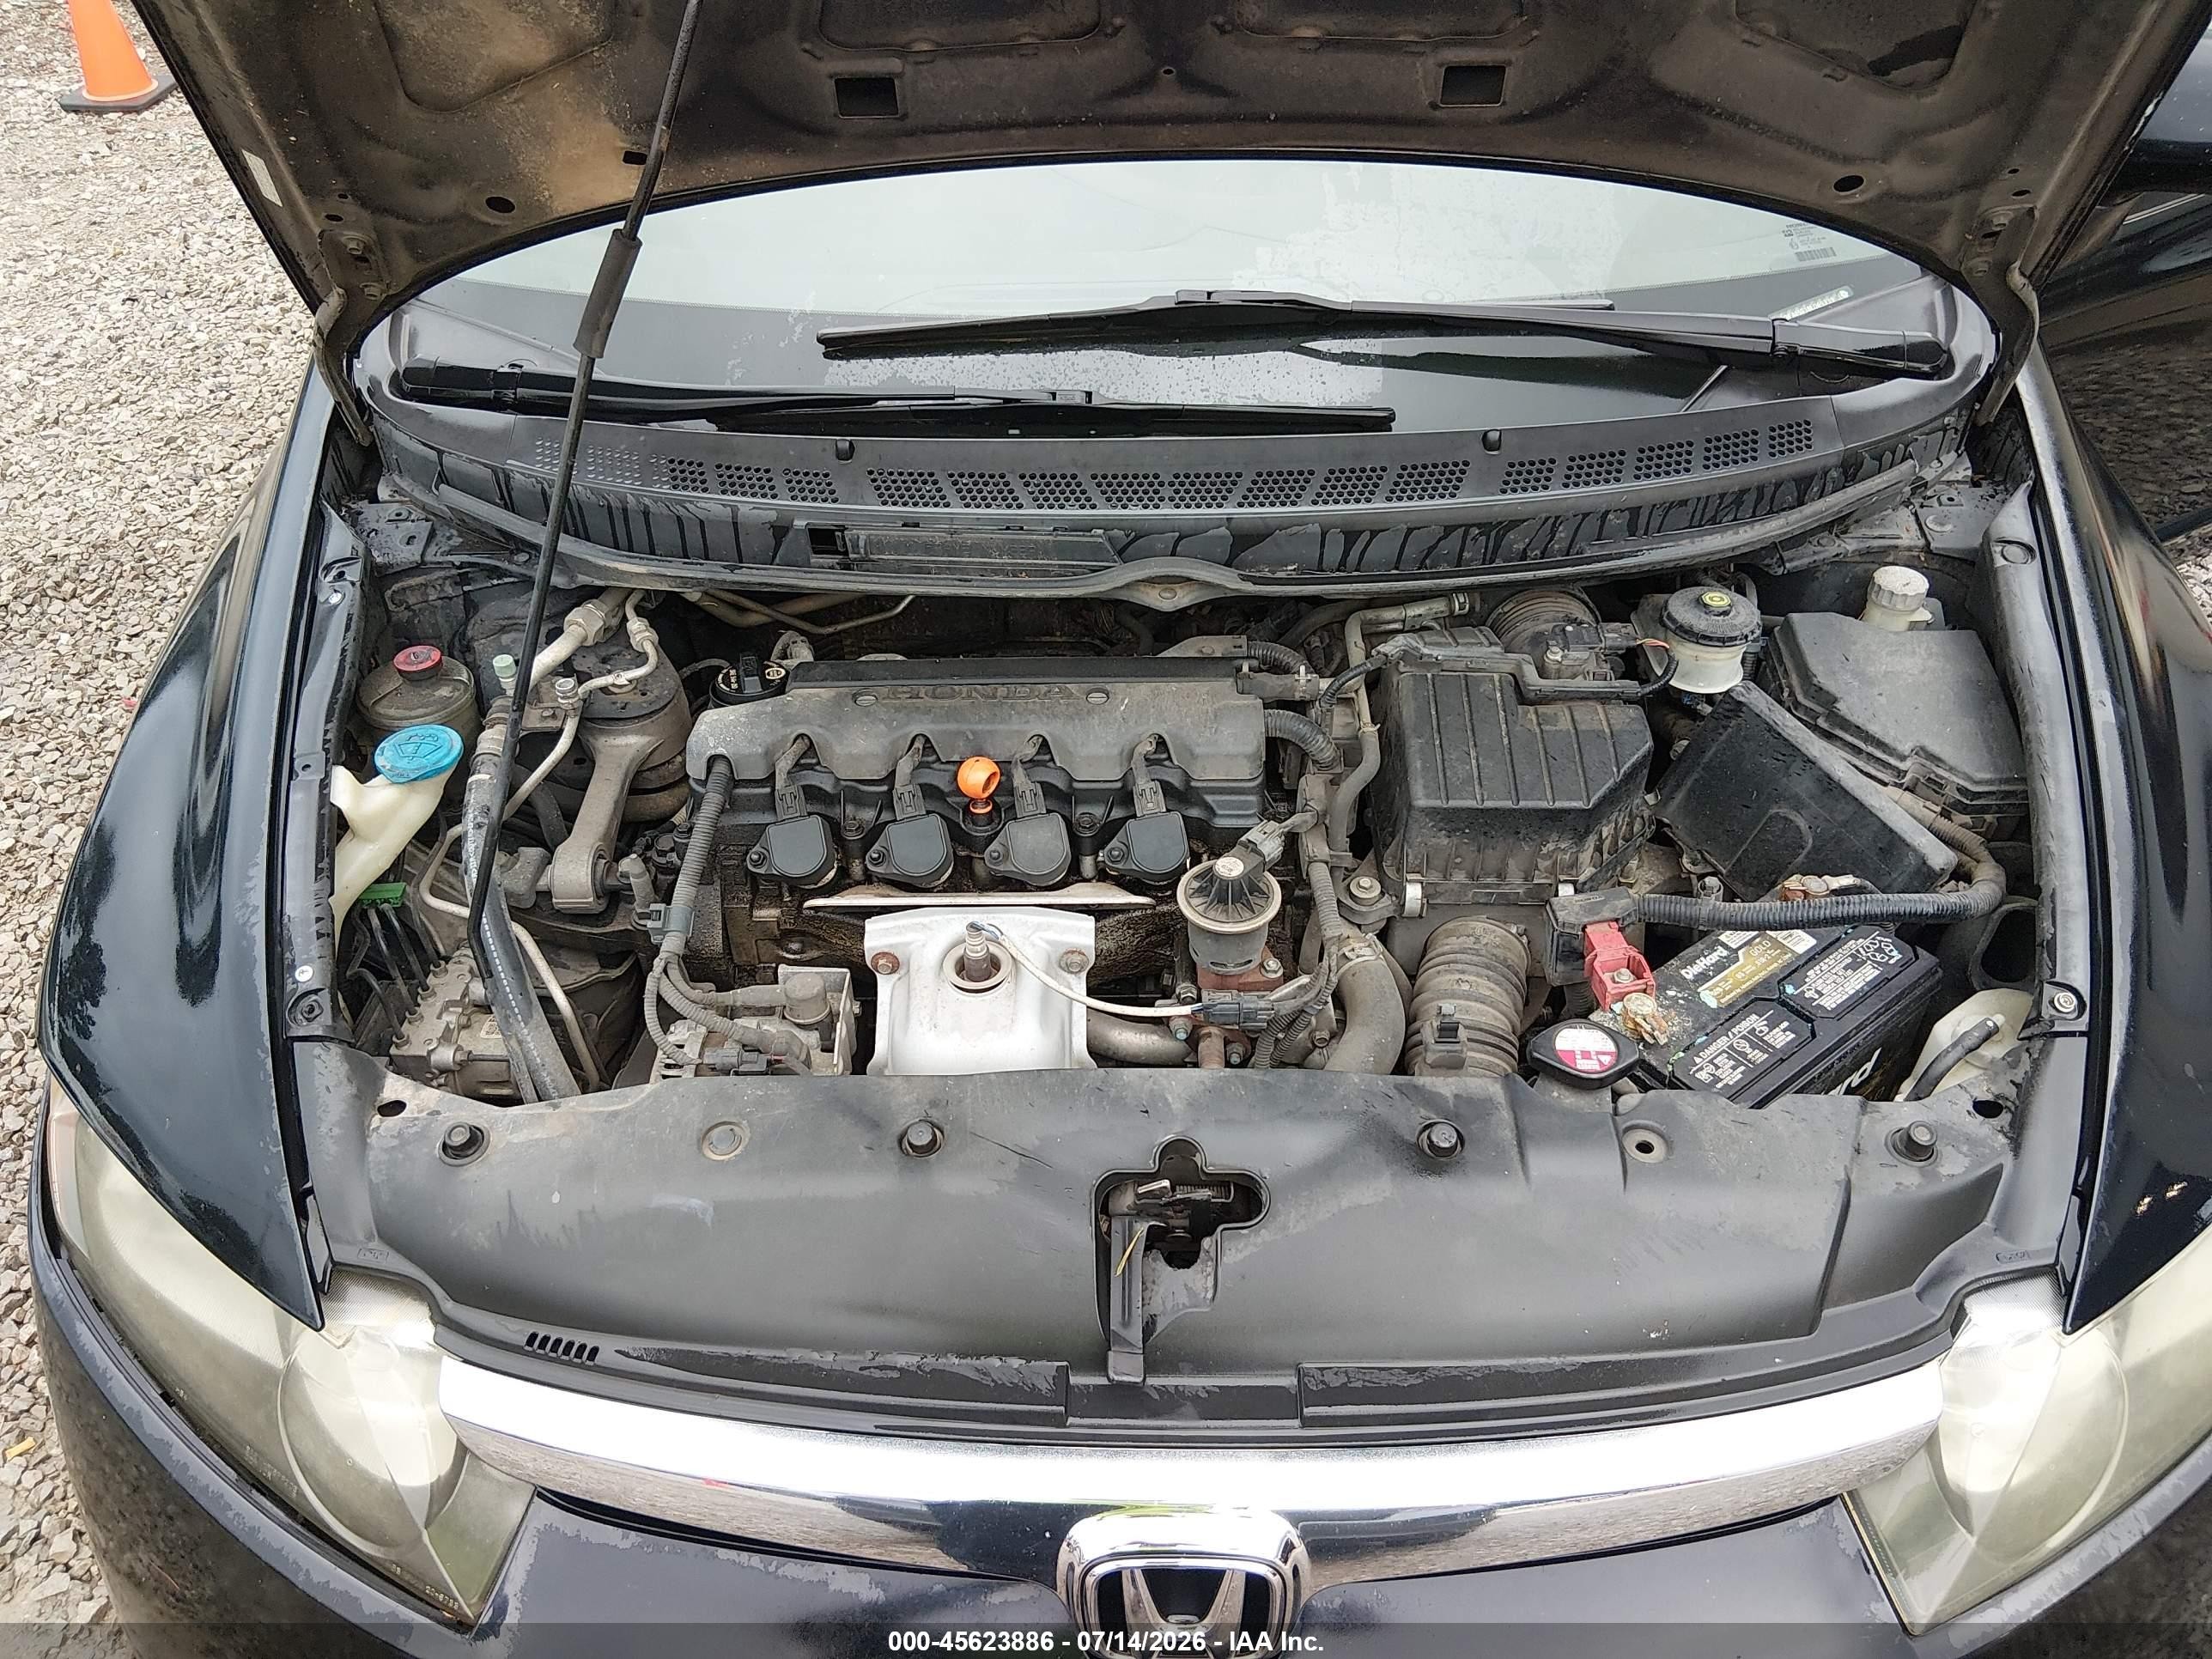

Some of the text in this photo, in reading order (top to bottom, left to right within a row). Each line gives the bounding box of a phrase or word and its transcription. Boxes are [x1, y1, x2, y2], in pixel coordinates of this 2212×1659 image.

[883, 684, 1081, 702] HONDA
[1750, 940, 1772, 957] GOLD
[1680, 945, 1729, 981] DieHard
[1698, 1036, 1729, 1059] DANGER
[1731, 1013, 1761, 1035] POISON
